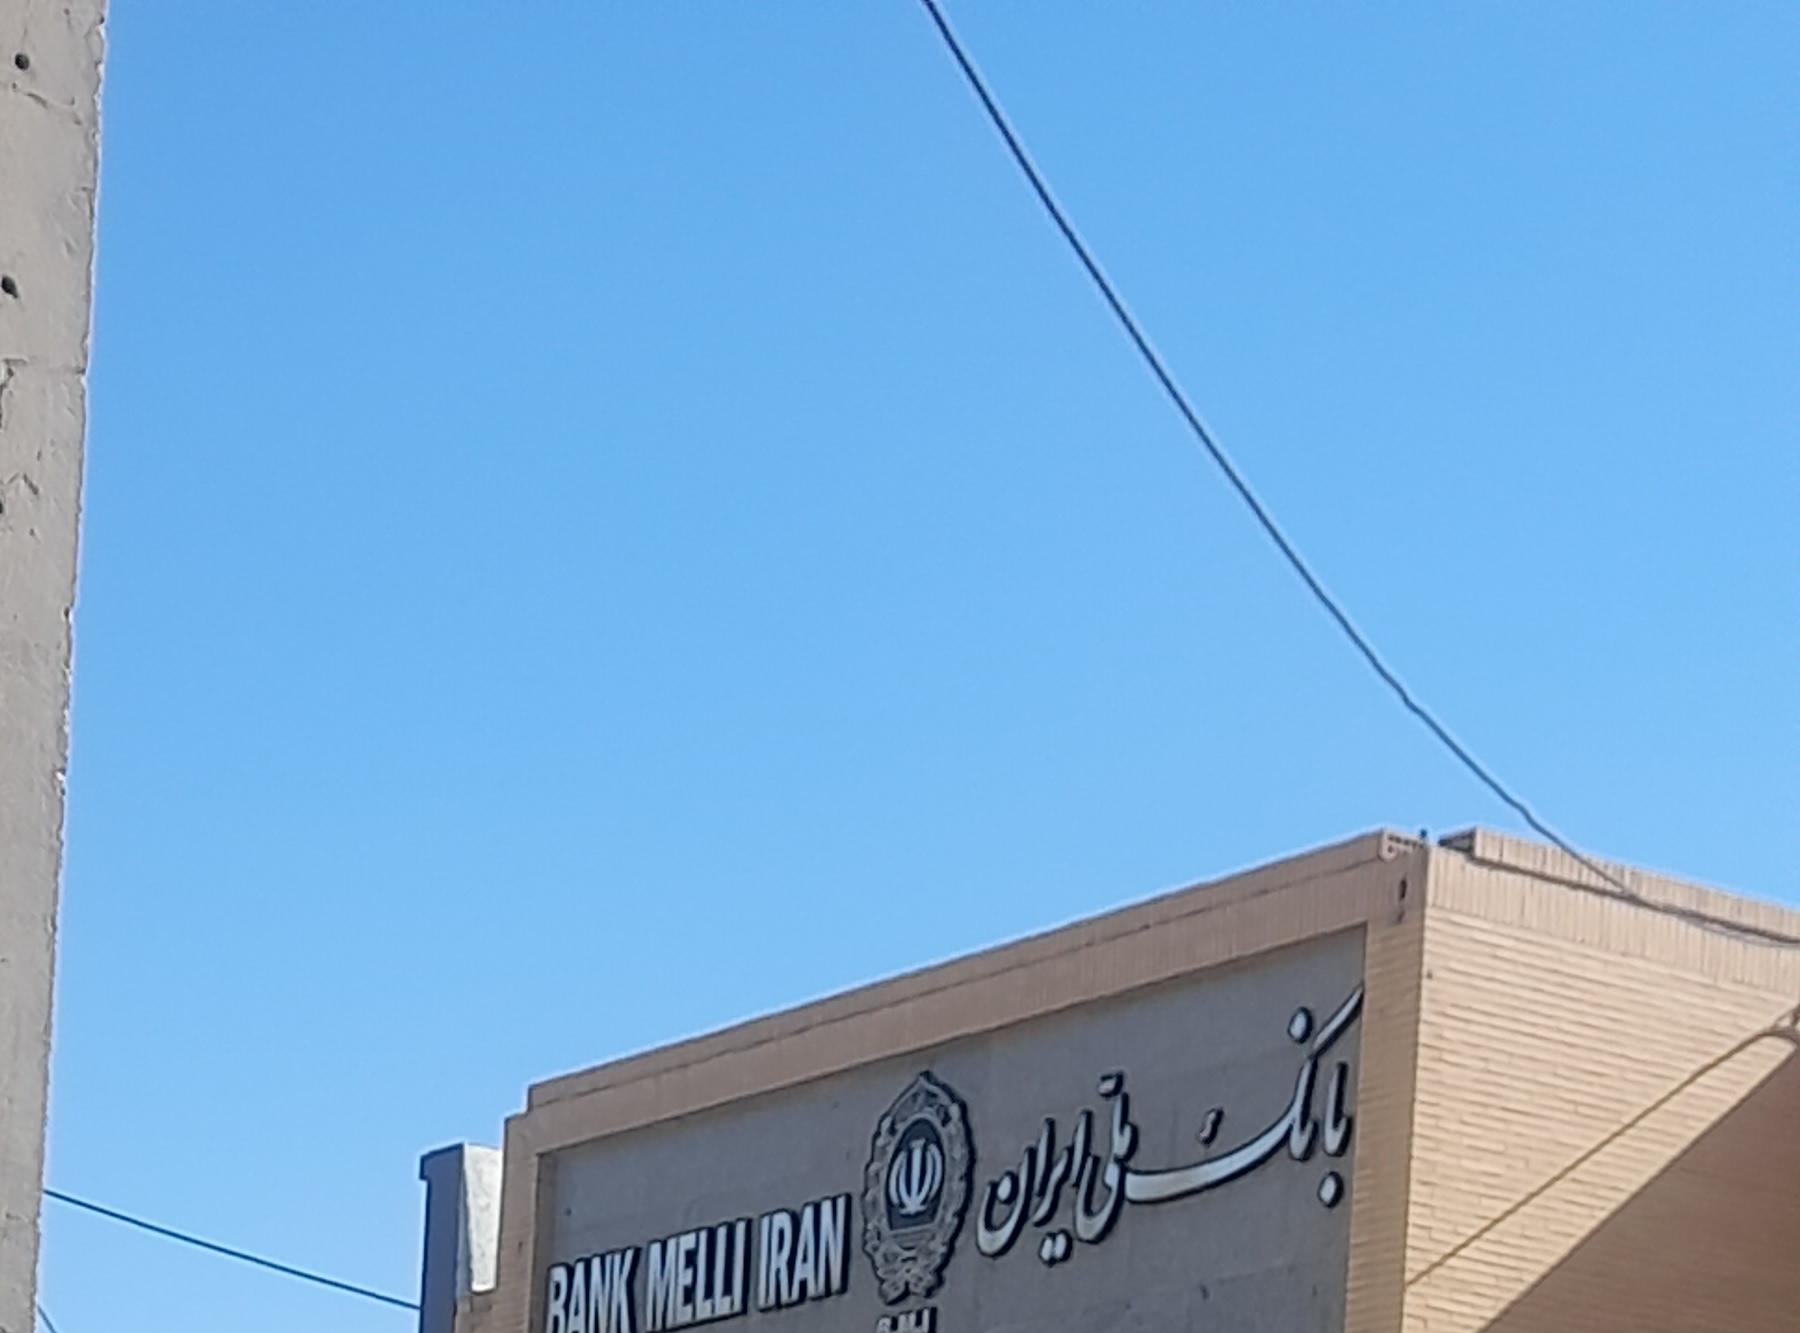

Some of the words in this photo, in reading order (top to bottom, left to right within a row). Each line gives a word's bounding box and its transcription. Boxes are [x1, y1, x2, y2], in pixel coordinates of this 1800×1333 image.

[1124, 986, 1362, 1206] بانک
[757, 1193, 851, 1312] IRAN
[976, 1110, 1095, 1265] ایران
